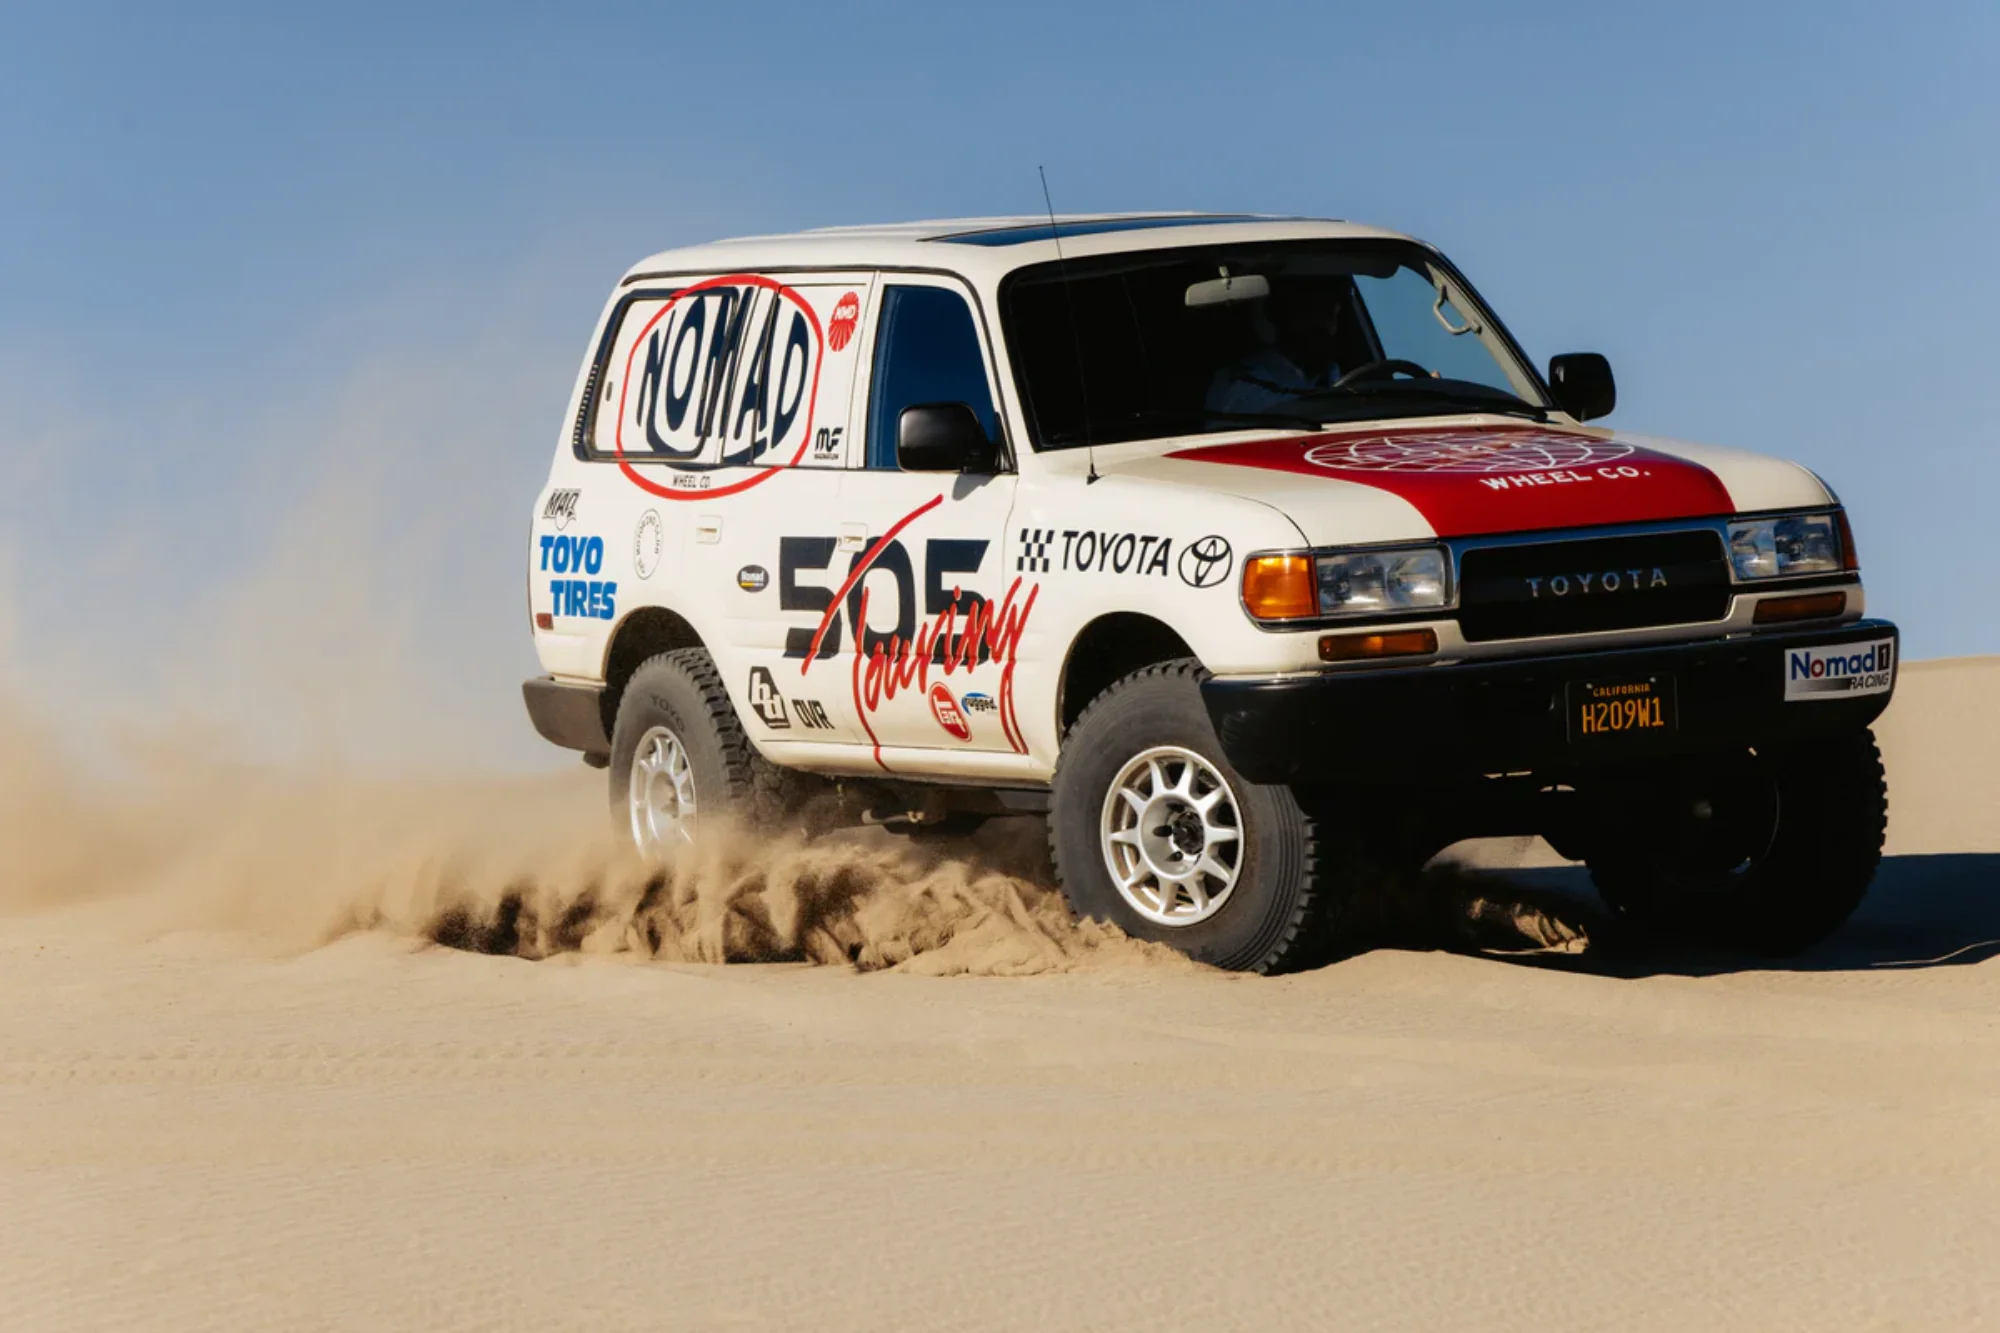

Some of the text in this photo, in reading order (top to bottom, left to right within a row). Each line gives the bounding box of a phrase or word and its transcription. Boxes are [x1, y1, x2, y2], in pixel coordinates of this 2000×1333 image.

[636, 286, 809, 471] NOMAD
[1481, 470, 1592, 490] WHEEL
[540, 535, 604, 575] TOYO
[1062, 530, 1173, 577] TOYOTA
[550, 580, 617, 620] TIRES
[779, 536, 990, 666] 505
[1526, 567, 1668, 597] TOYOTA
[1790, 644, 1876, 680] Nomad
[1593, 683, 1651, 698] CALIFORNIA
[1850, 673, 1889, 690] RACING
[1582, 696, 1665, 734] H209W1
